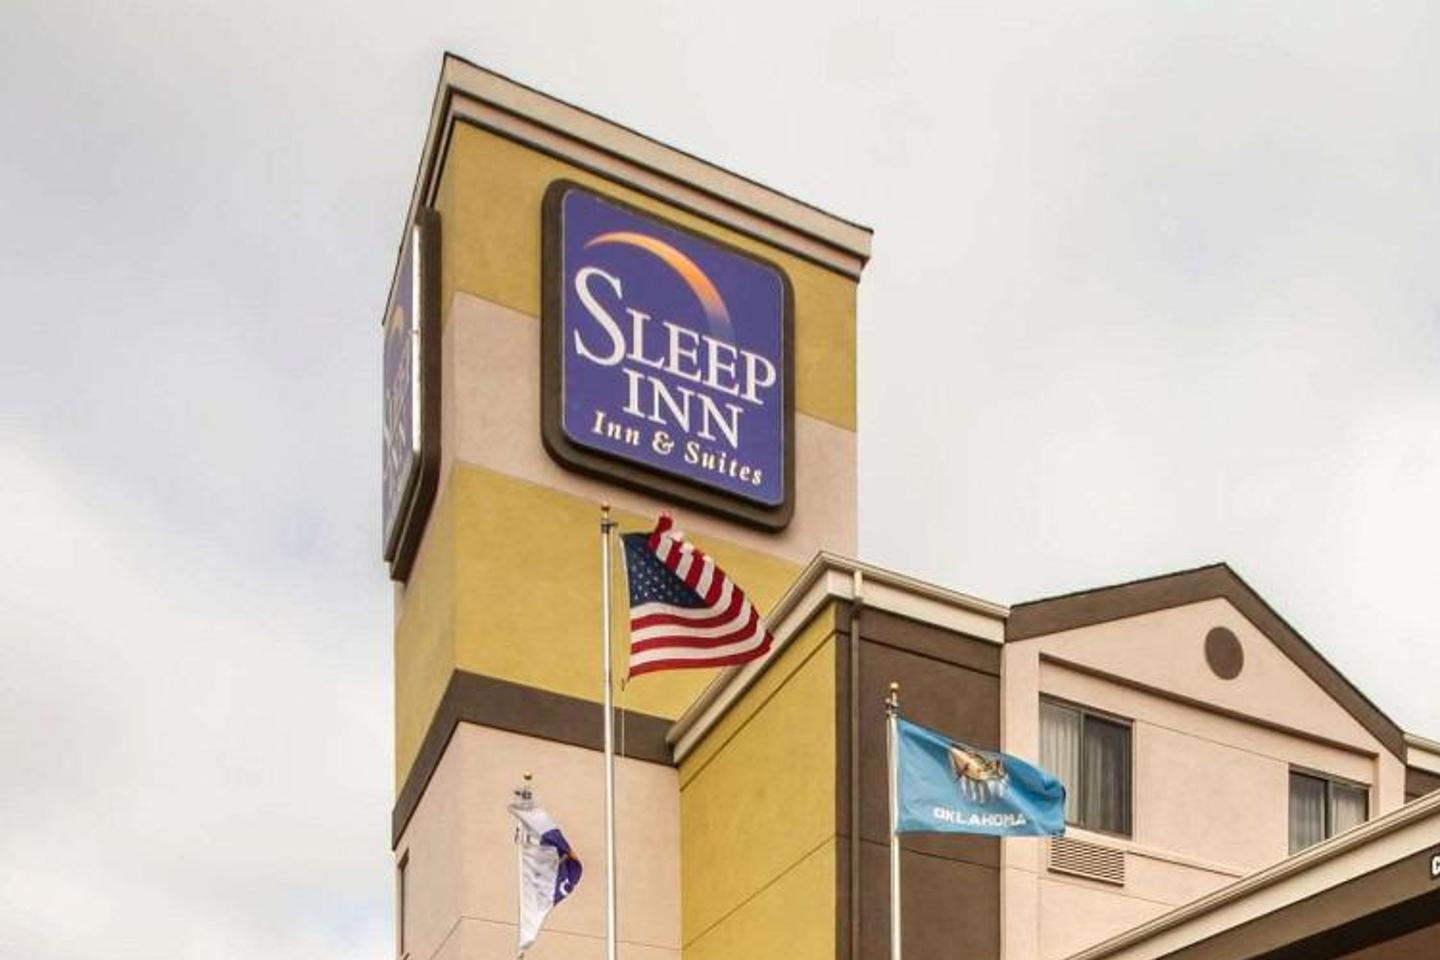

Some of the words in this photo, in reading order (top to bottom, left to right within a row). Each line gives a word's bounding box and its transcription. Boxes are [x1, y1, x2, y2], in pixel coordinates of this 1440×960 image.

[574, 266, 776, 406] SLEEP
[622, 368, 744, 449] INN
[592, 411, 641, 446] Inn
[652, 432, 675, 455] &
[684, 441, 763, 486] Suites
[933, 806, 1027, 827] OKLAHOMA
